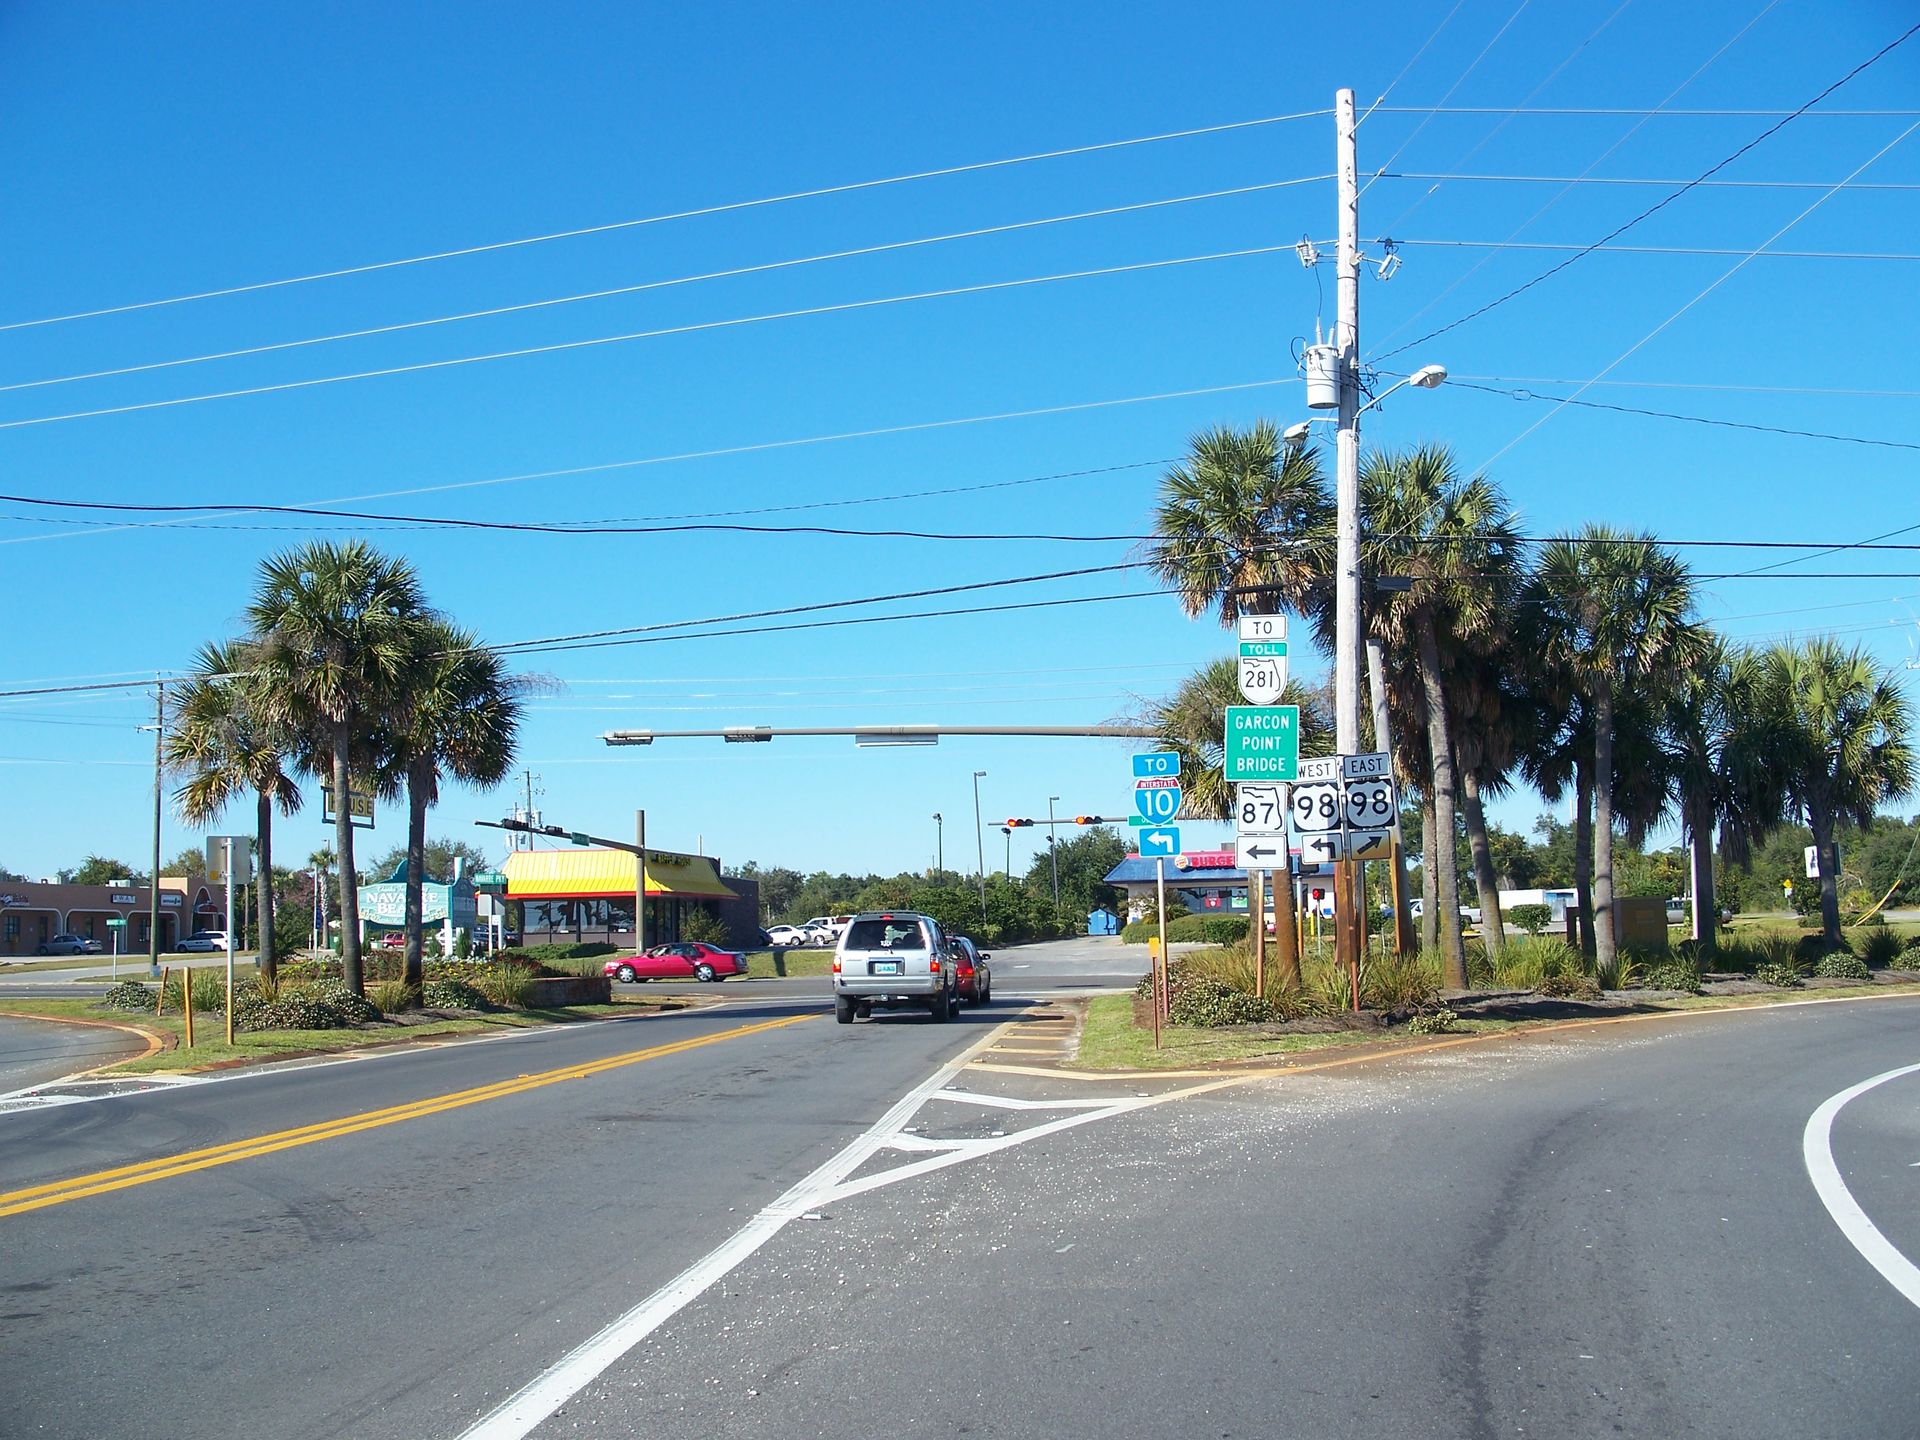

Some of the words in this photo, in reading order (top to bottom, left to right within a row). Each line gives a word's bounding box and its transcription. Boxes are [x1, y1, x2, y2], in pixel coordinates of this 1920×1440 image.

[1253, 621, 1273, 635] TO
[1247, 644, 1279, 655] TOLL
[1245, 671, 1275, 689] 281
[1235, 715, 1290, 730] GARCON
[1242, 736, 1281, 751] POINT
[1144, 757, 1167, 772] TO
[1236, 757, 1286, 772] BRIDGE
[1298, 763, 1331, 778] WEST
[1351, 757, 1383, 773] EAST
[1140, 779, 1175, 788] INTERSTATE
[1144, 788, 1174, 816] 10
[1296, 792, 1336, 820] 98
[1350, 788, 1389, 817] 98
[1242, 802, 1275, 824] 87
[1191, 856, 1233, 867] BURGE
[366, 892, 439, 903] NAVARE
